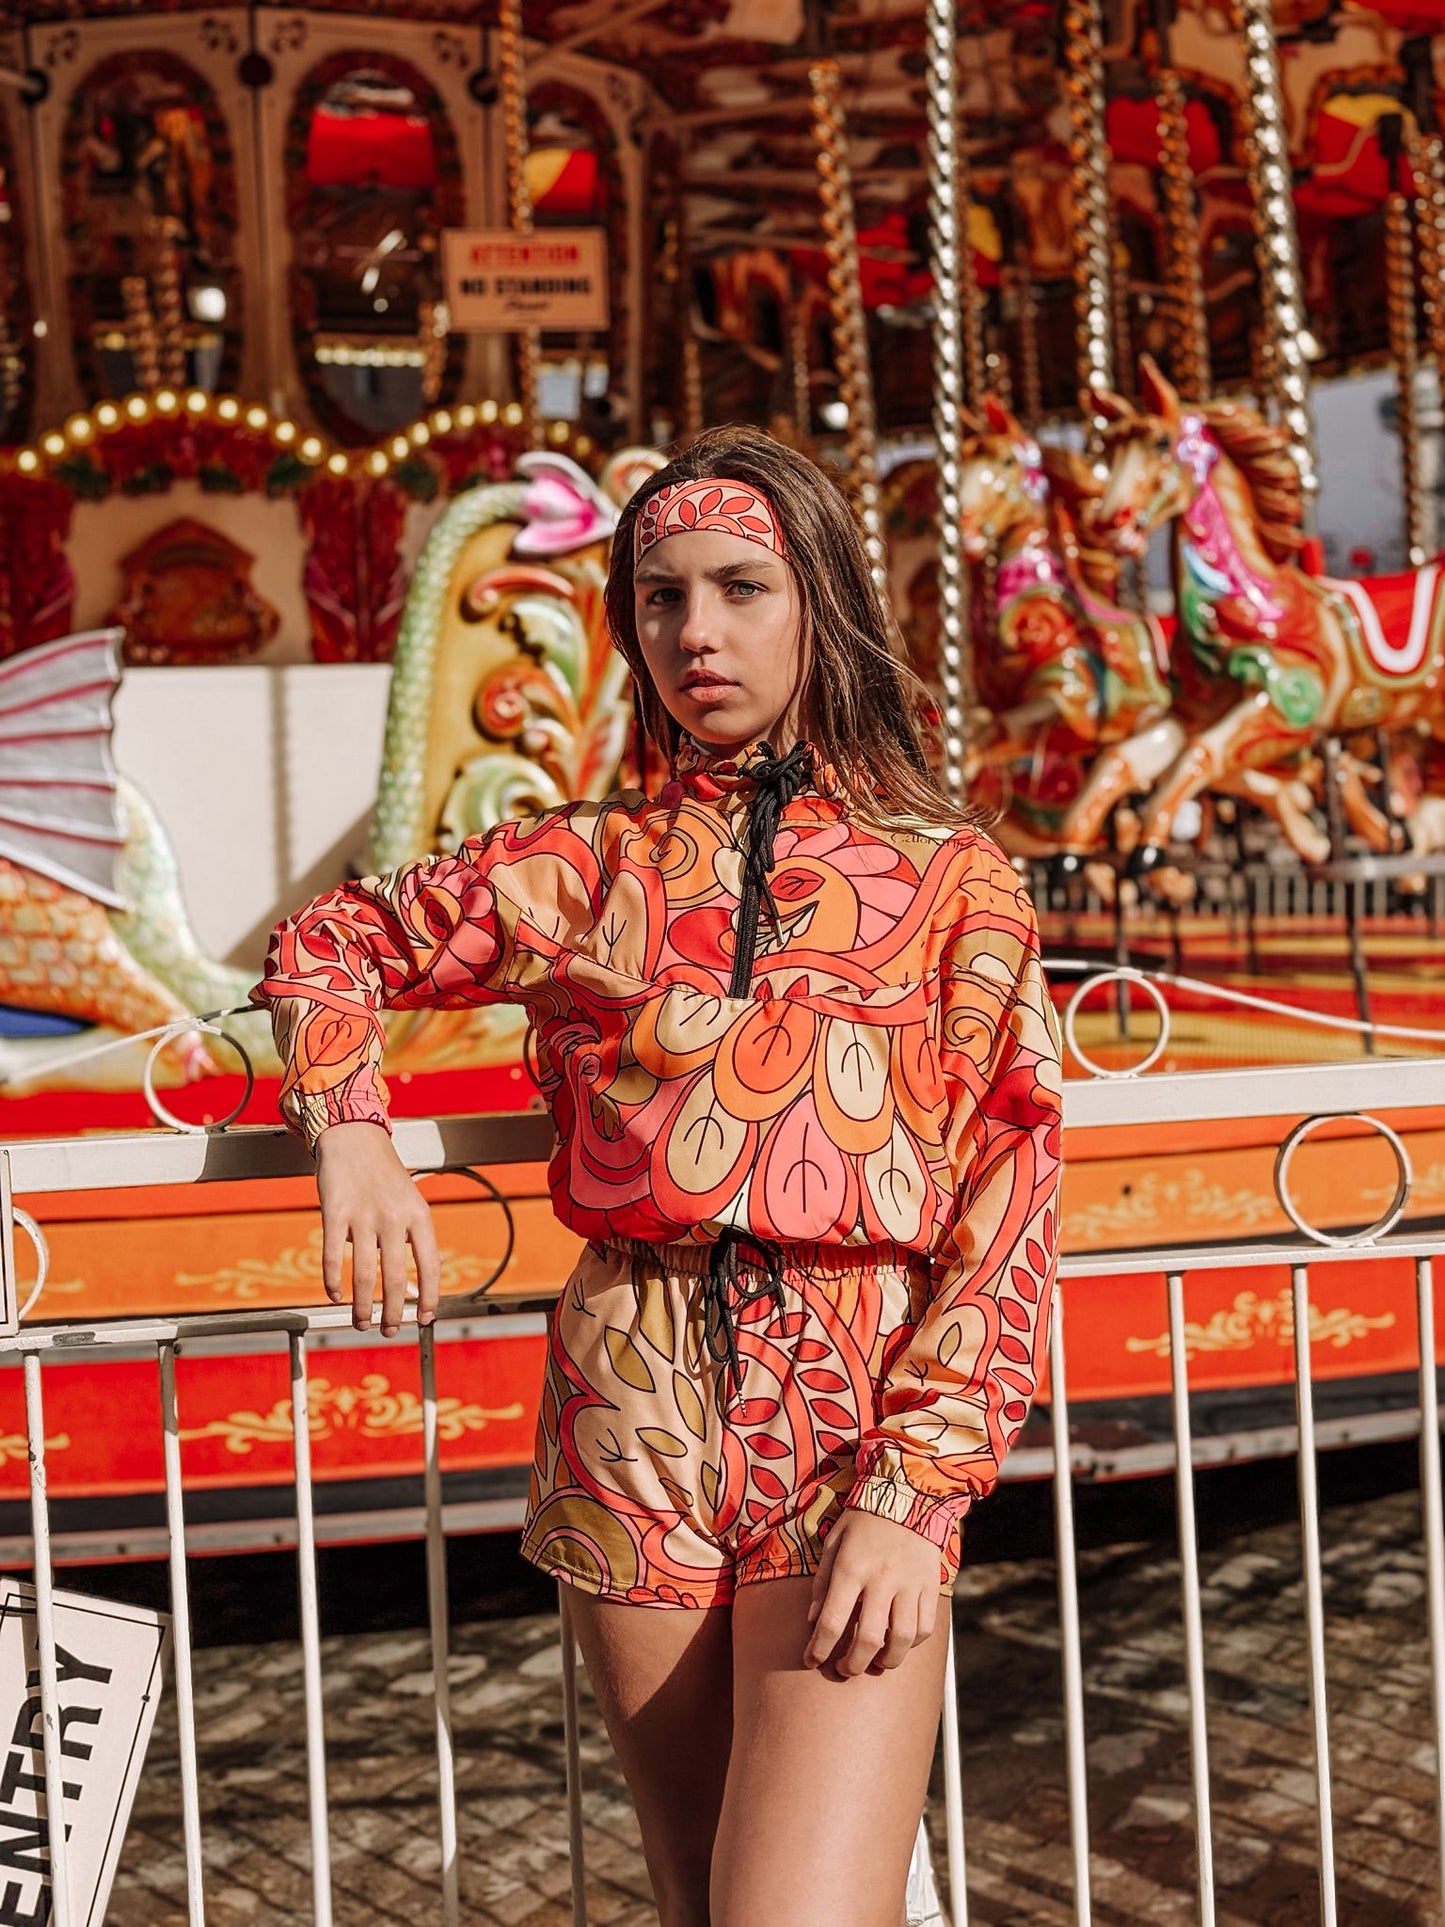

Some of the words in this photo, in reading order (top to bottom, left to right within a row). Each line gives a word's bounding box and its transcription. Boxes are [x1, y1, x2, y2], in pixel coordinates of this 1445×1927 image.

[470, 243, 579, 265] ATTENTION
[460, 277, 485, 295] NO
[496, 277, 591, 295] STANDING
[0, 1635, 113, 1927] ENTRY
